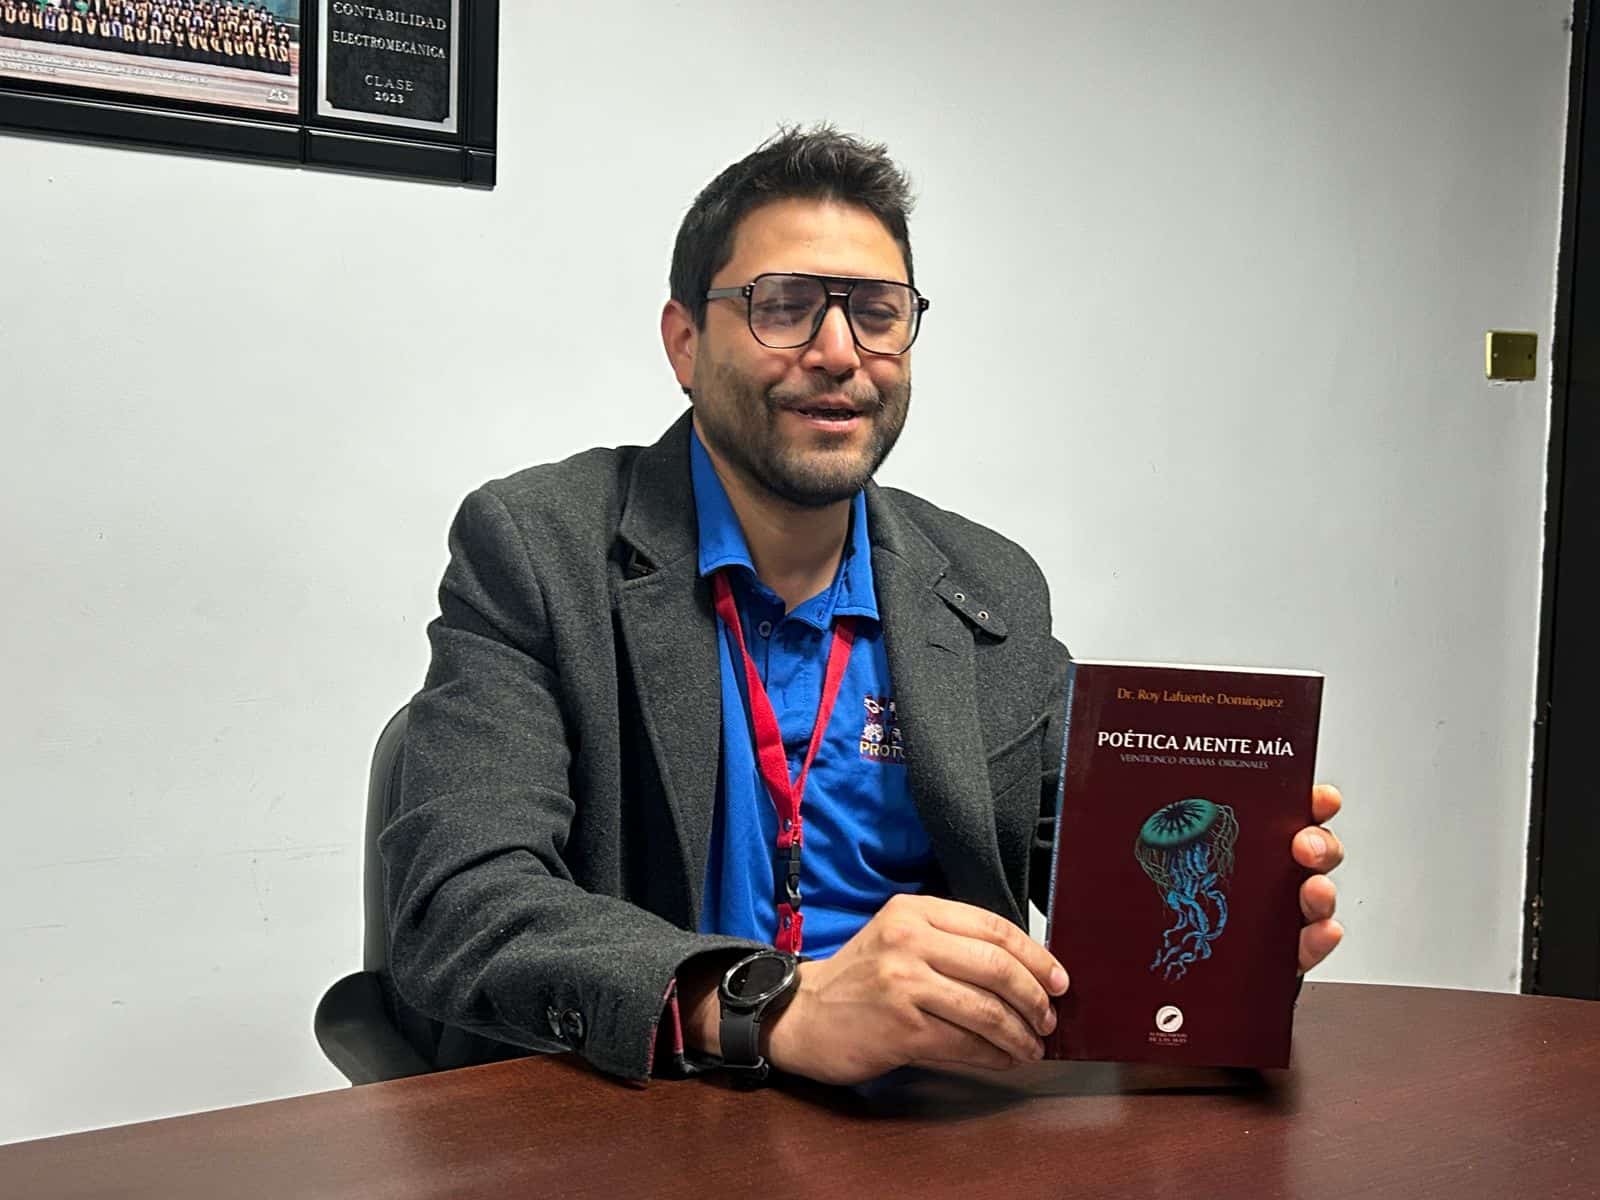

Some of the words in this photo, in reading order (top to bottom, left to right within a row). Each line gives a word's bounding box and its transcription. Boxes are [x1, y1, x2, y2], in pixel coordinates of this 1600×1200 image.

[333, 1, 447, 30] CONTABILIDAD
[332, 30, 447, 59] ELECTROMECANICA
[365, 74, 414, 91] CLASE
[375, 91, 404, 104] 2023
[1117, 687, 1135, 700] Dr.
[1138, 689, 1159, 704] Roy
[1163, 690, 1214, 704] Lafuente
[1098, 729, 1179, 750] POÉTICA
[1183, 735, 1252, 754] MENTE
[1256, 737, 1295, 757] MÍA
[1178, 755, 1216, 766] POEMAS
[1218, 758, 1269, 770] ORIGINALES
